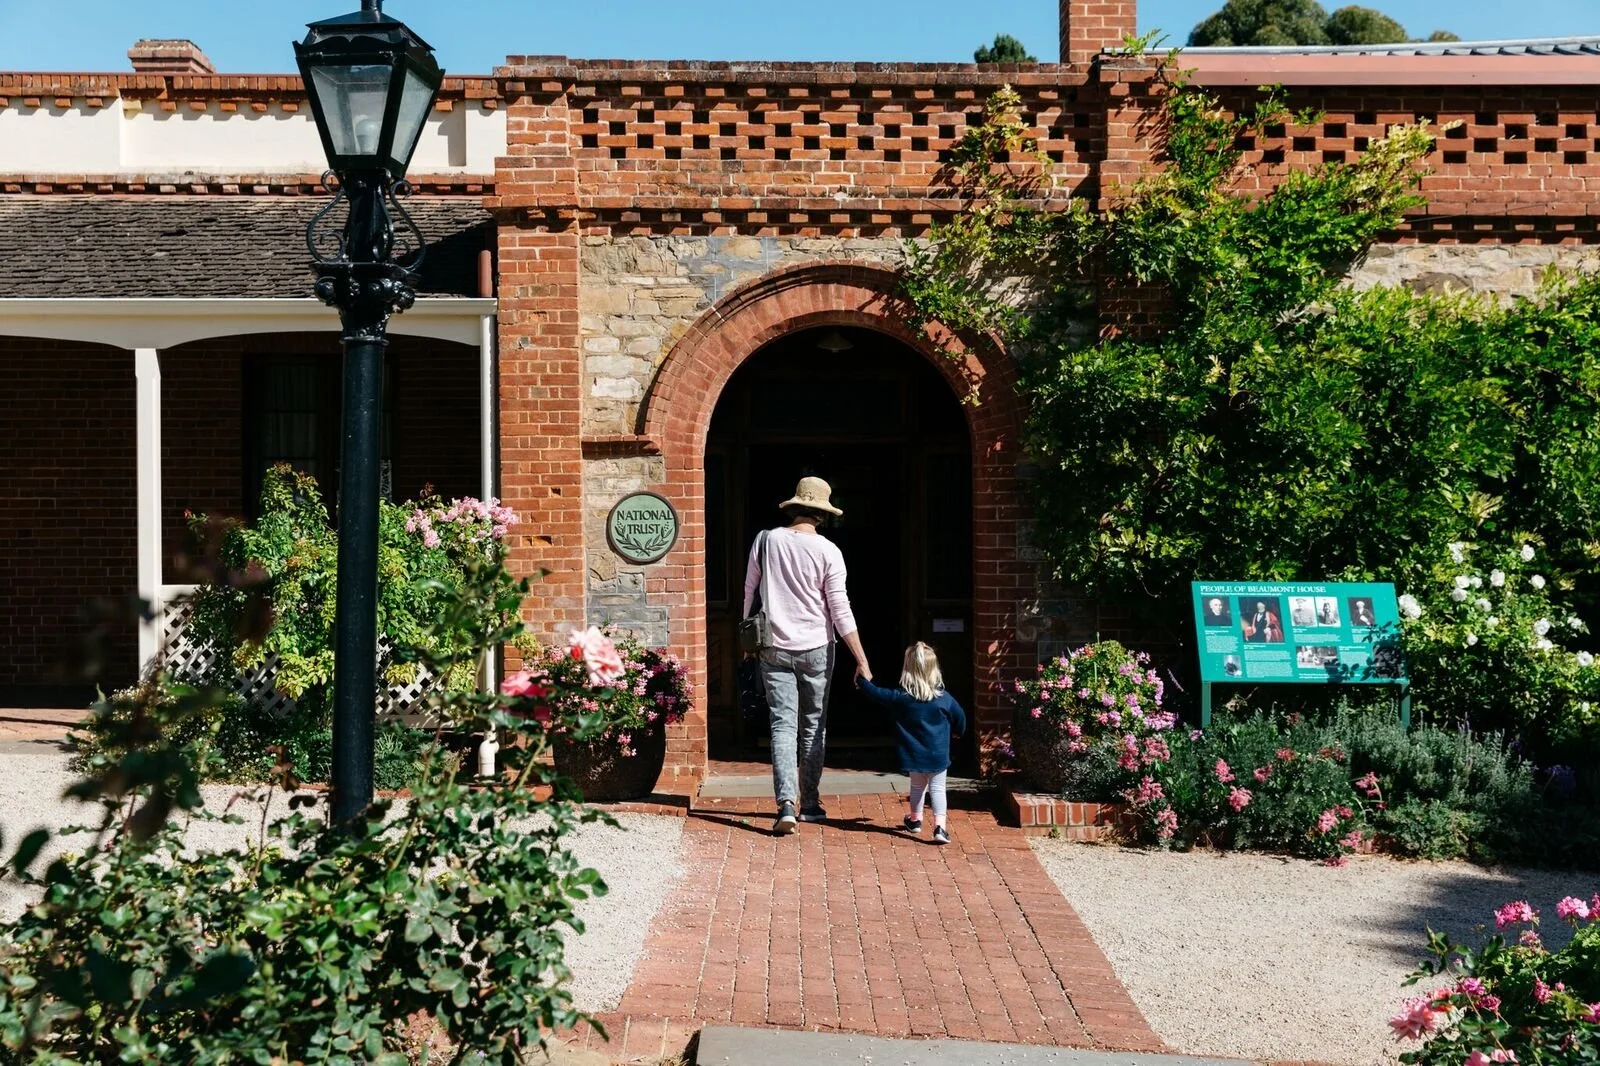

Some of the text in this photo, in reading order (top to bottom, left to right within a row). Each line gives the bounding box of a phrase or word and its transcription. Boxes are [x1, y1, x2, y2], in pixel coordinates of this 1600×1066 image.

[616, 510, 674, 520] NATIONAL
[627, 523, 660, 534] TRUST
[1297, 585, 1326, 593] HOUSE
